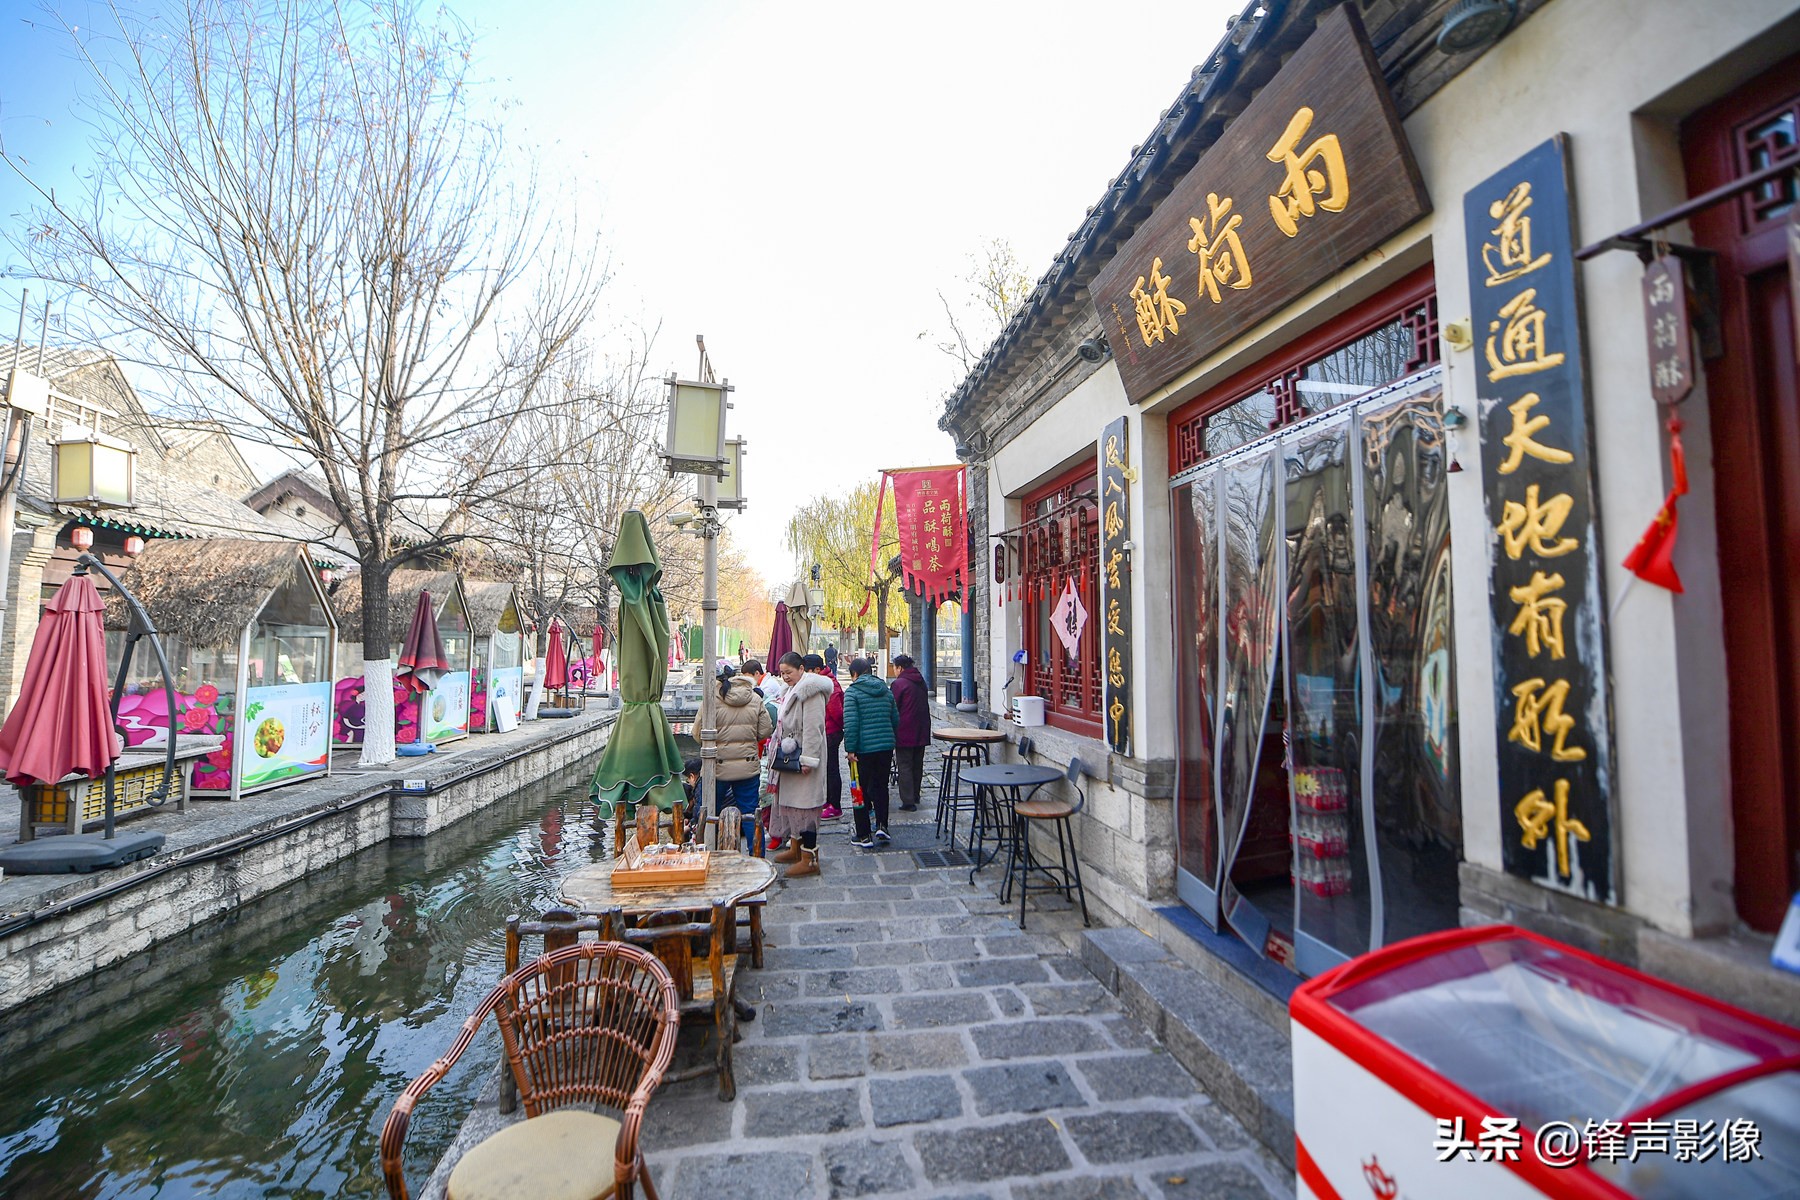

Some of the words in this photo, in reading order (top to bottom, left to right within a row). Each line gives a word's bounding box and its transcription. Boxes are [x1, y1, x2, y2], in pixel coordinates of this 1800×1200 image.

[1130, 106, 1349, 347] 雨荷酥
[1649, 274, 1684, 389] 雨荷酥
[922, 499, 943, 573] 品酥喝茶
[939, 499, 953, 537] 雨荷酥
[1482, 181, 1591, 877] 道通天地有形外
